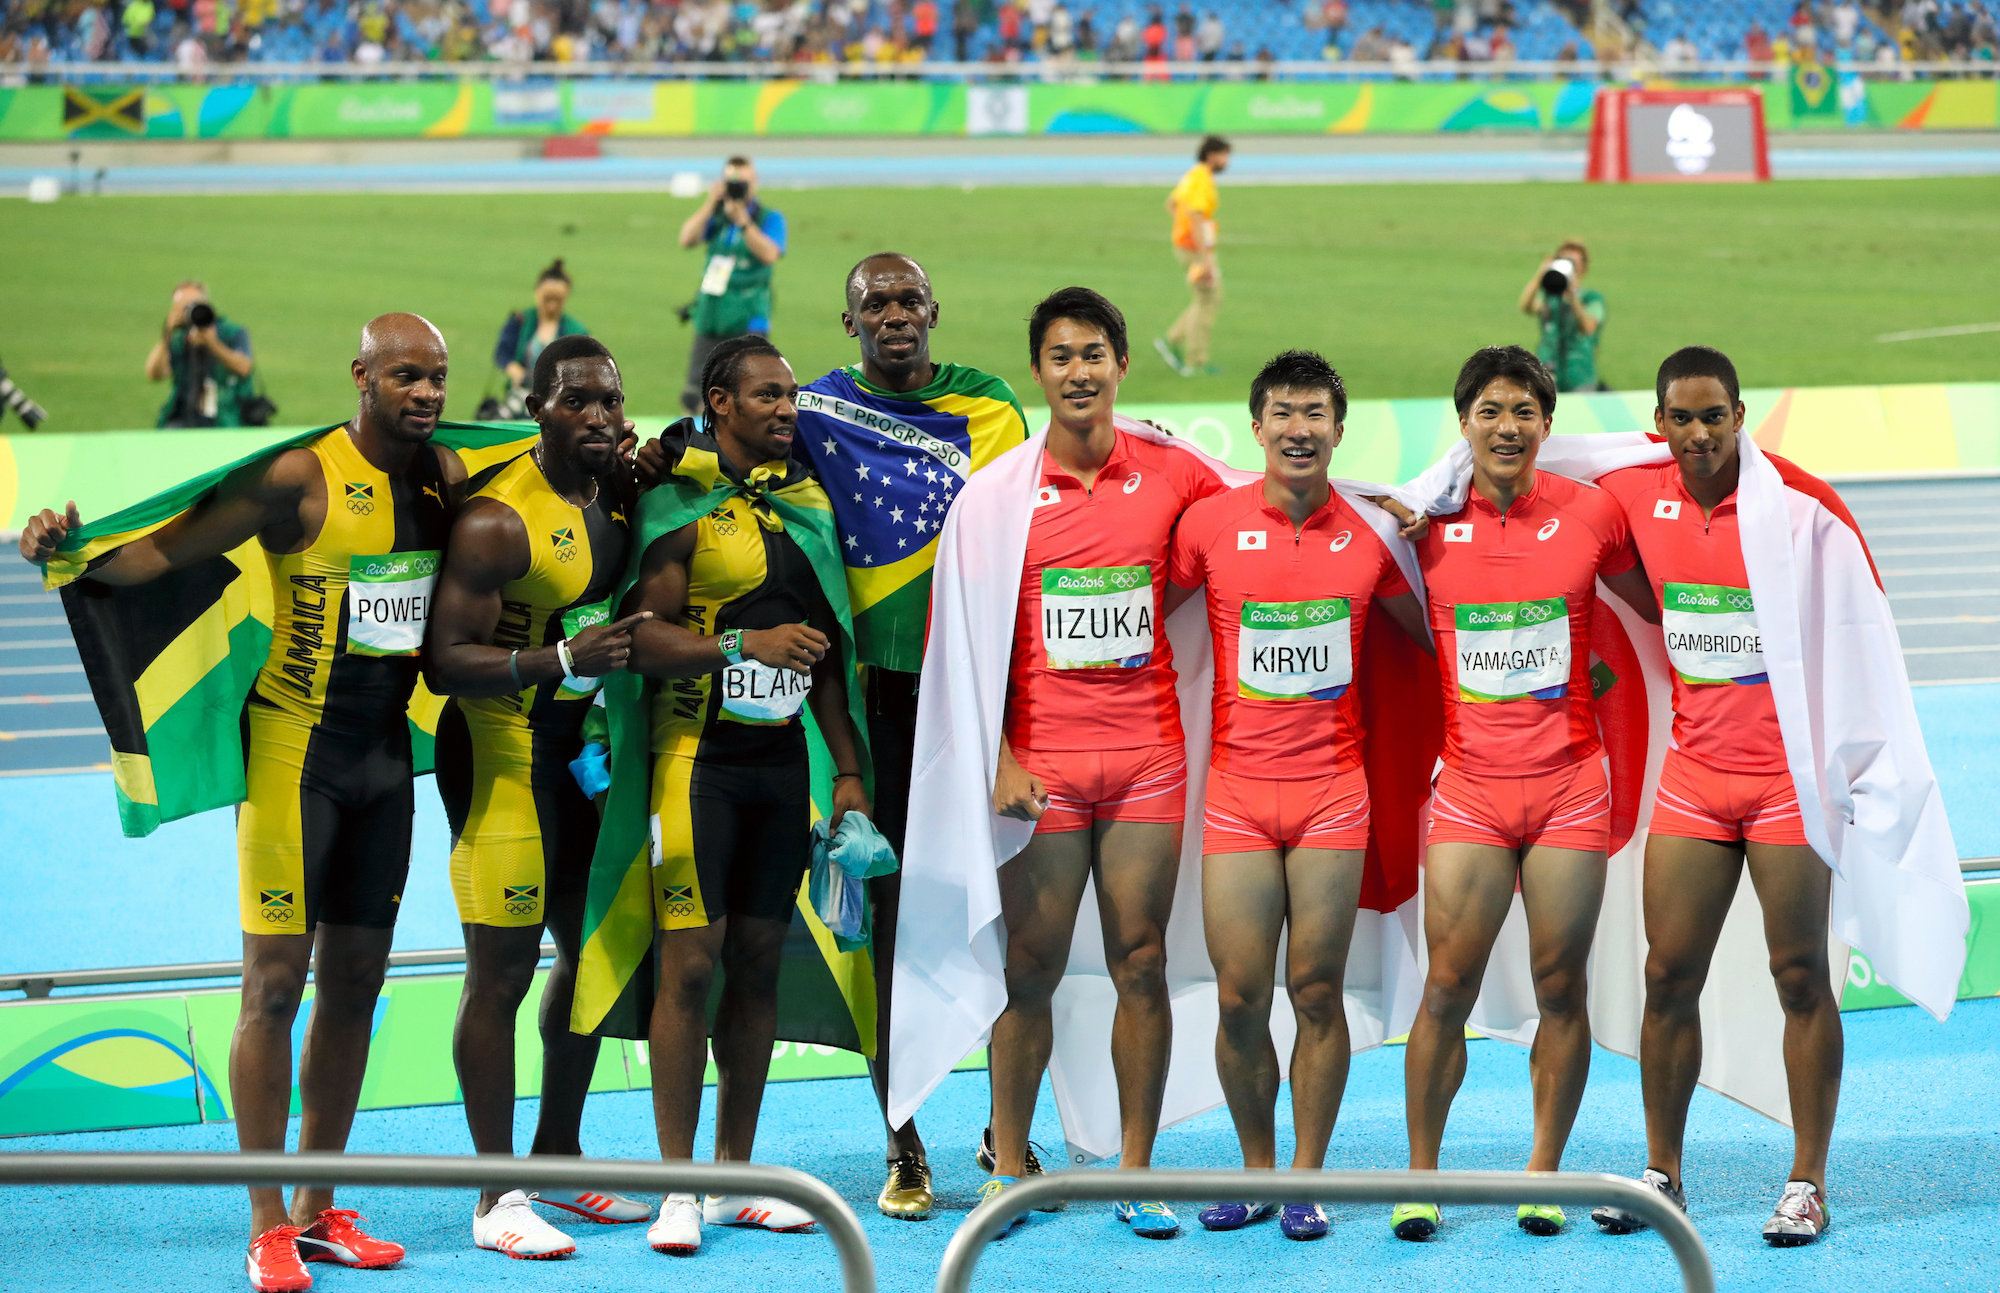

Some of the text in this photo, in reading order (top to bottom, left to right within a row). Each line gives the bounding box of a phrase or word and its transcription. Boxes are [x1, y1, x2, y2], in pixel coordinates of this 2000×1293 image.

[834, 401, 846, 416] E
[854, 408, 961, 467] PROGRESSO
[365, 561, 409, 575] Rio2016
[1057, 575, 1105, 589] Rio2016
[1677, 592, 1720, 606] Rio2016
[1046, 606, 1152, 639] IIZUKA
[1250, 610, 1299, 623] Rio2016
[1468, 610, 1514, 624] Rio2016
[281, 575, 327, 699] JAMAICA
[1668, 632, 1764, 654] CAMBRIDGE
[1252, 645, 1329, 673] KIRYU
[1461, 646, 1562, 671] YAMAGATA
